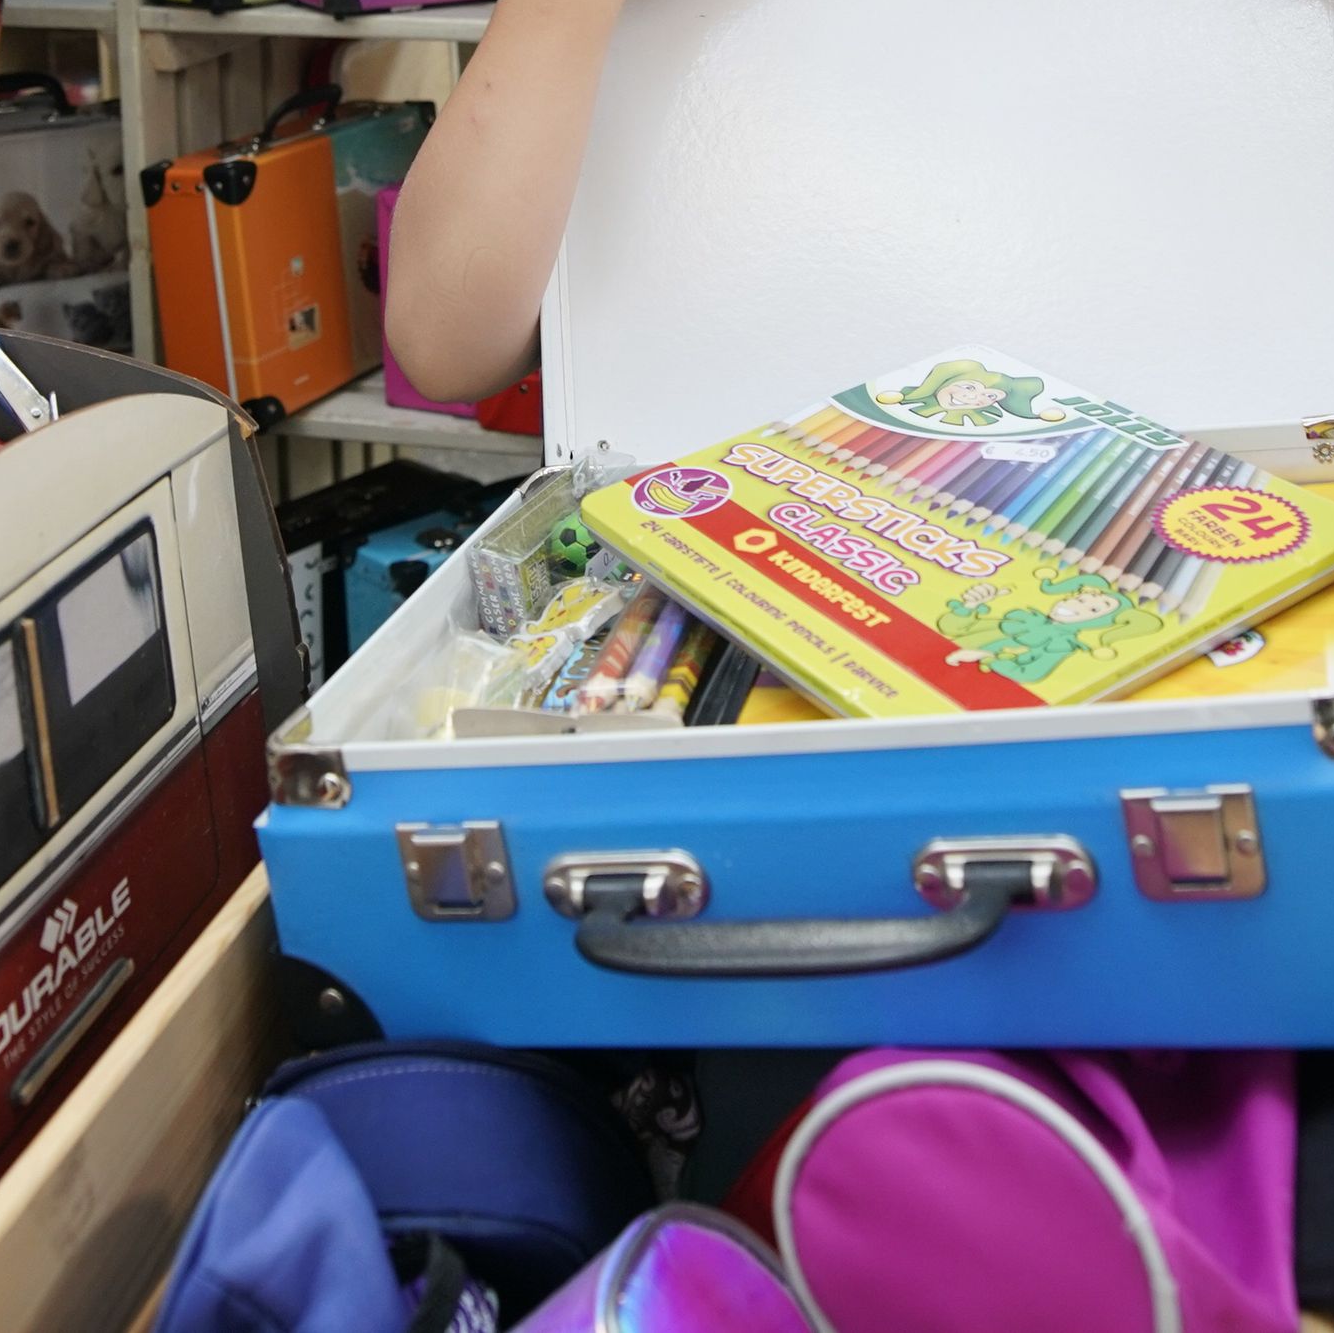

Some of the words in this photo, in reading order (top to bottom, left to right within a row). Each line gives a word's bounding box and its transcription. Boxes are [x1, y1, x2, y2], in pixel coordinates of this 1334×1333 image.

[722, 443, 1012, 578] SUPERSTICKS
[1189, 510, 1244, 548] FARBEN
[1201, 496, 1295, 540] 24
[767, 502, 920, 595] CLASSIC
